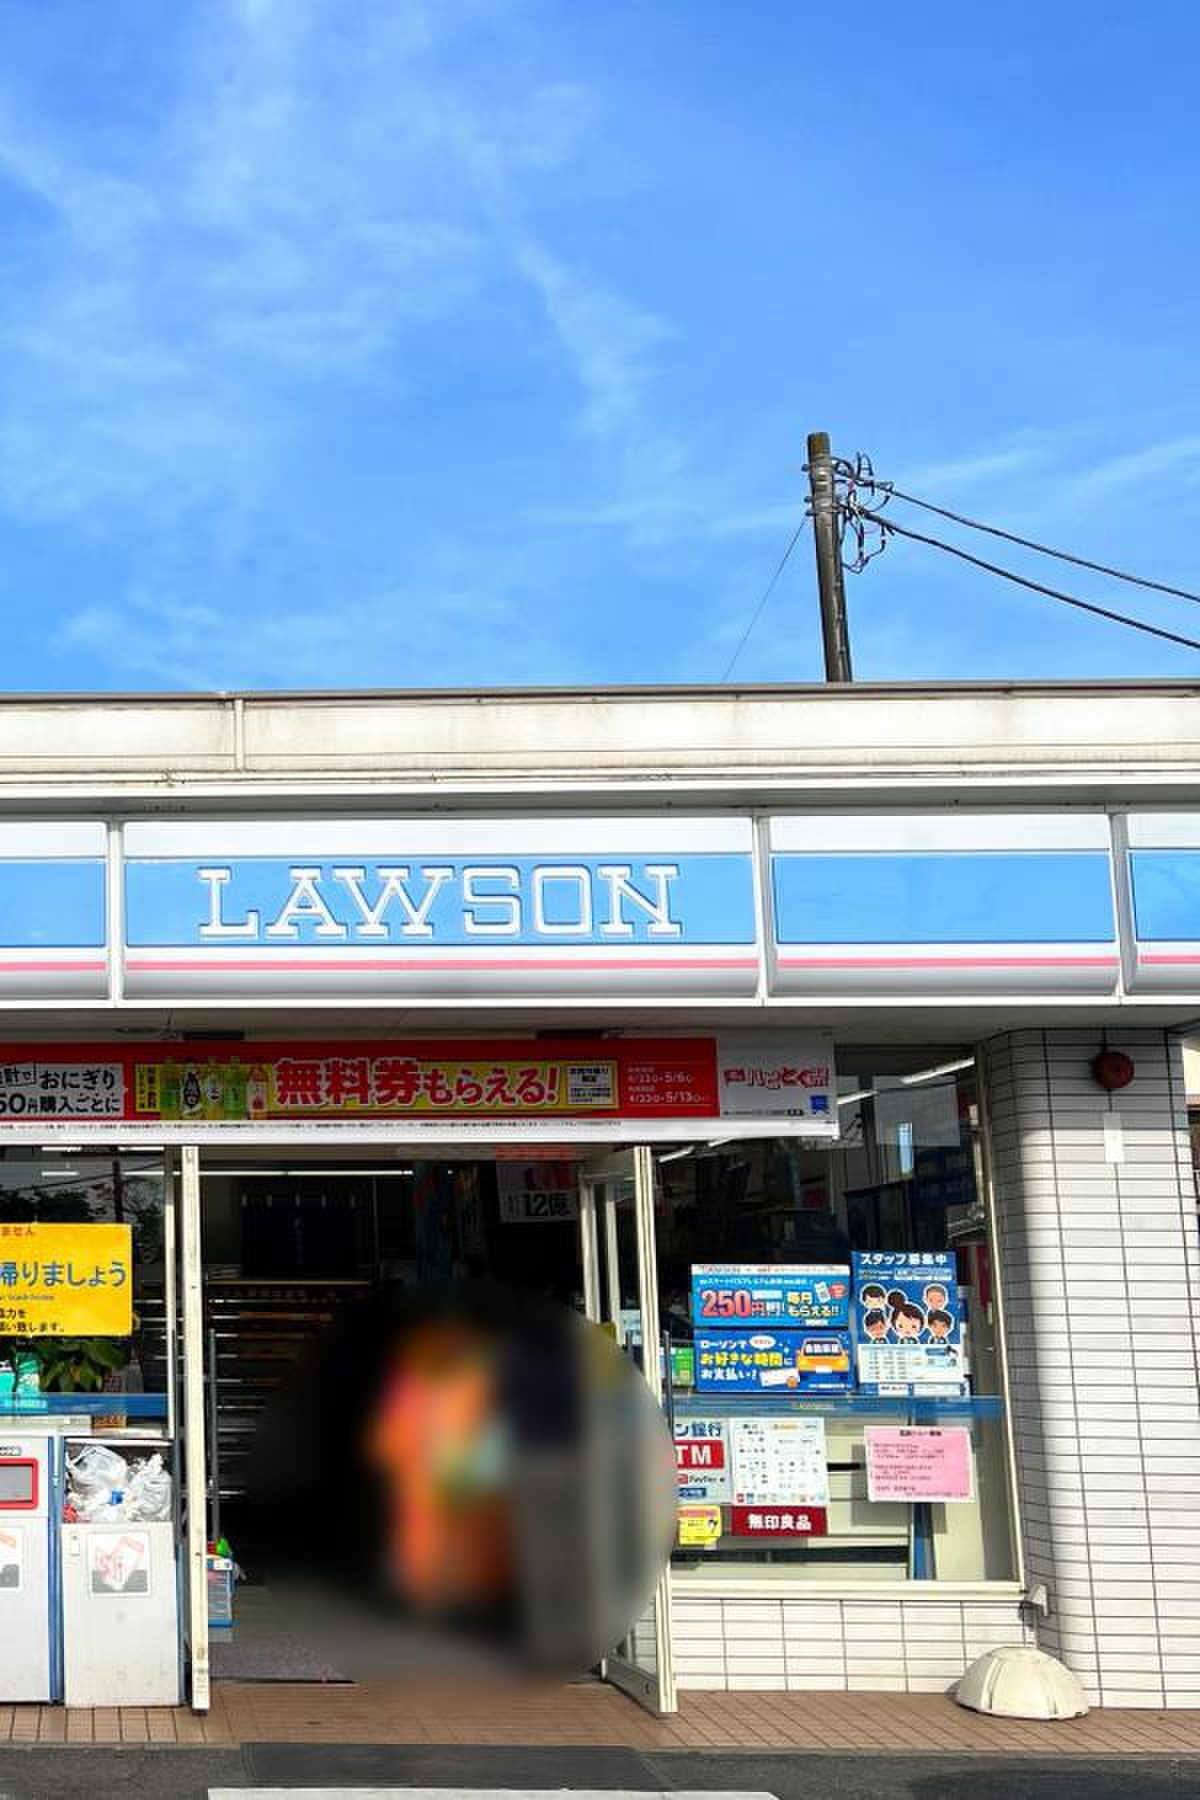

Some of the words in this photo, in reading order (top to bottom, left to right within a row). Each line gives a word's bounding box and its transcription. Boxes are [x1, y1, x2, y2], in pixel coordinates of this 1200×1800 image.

[198, 865, 681, 938] LAWSON
[39, 1068, 116, 1090] おにぎり
[273, 1058, 561, 1107] 無料券もらえる!
[861, 1253, 947, 1265] スタッフ募集中
[787, 1291, 813, 1304] 毎月
[700, 1340, 747, 1349] ローソンで
[701, 1367, 757, 1381] お支払い!
[747, 1513, 813, 1531] 無印良品
